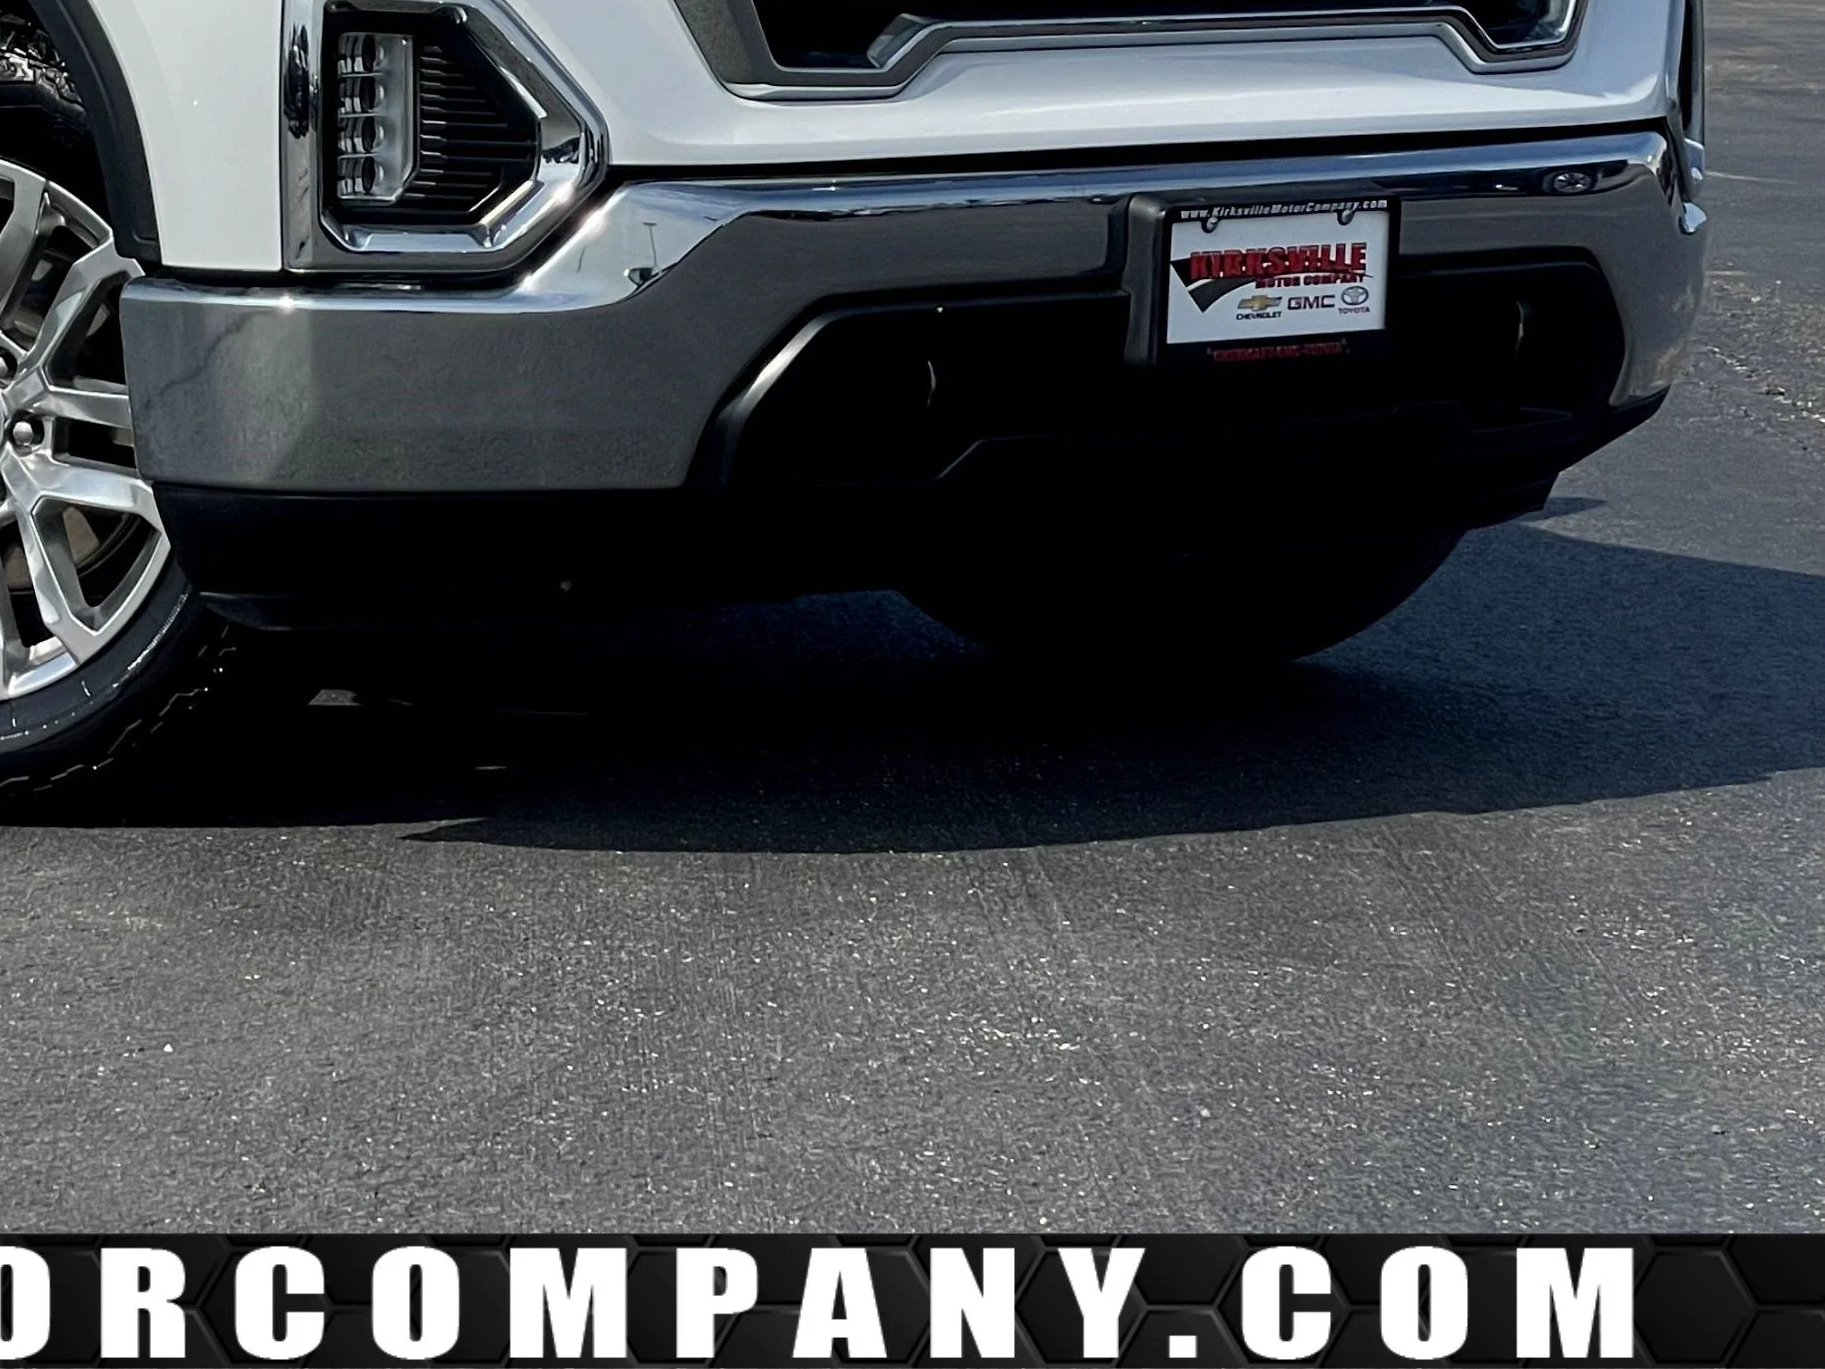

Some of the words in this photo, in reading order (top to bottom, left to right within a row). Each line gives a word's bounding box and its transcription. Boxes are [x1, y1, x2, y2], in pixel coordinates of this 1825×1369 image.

[1189, 242, 1367, 280] KIRKSVILLE
[1255, 276, 1301, 289] MOTOR
[1287, 295, 1336, 311] GMC
[1235, 311, 1282, 321] CHEVROLET
[1338, 306, 1371, 315] TOYOTA
